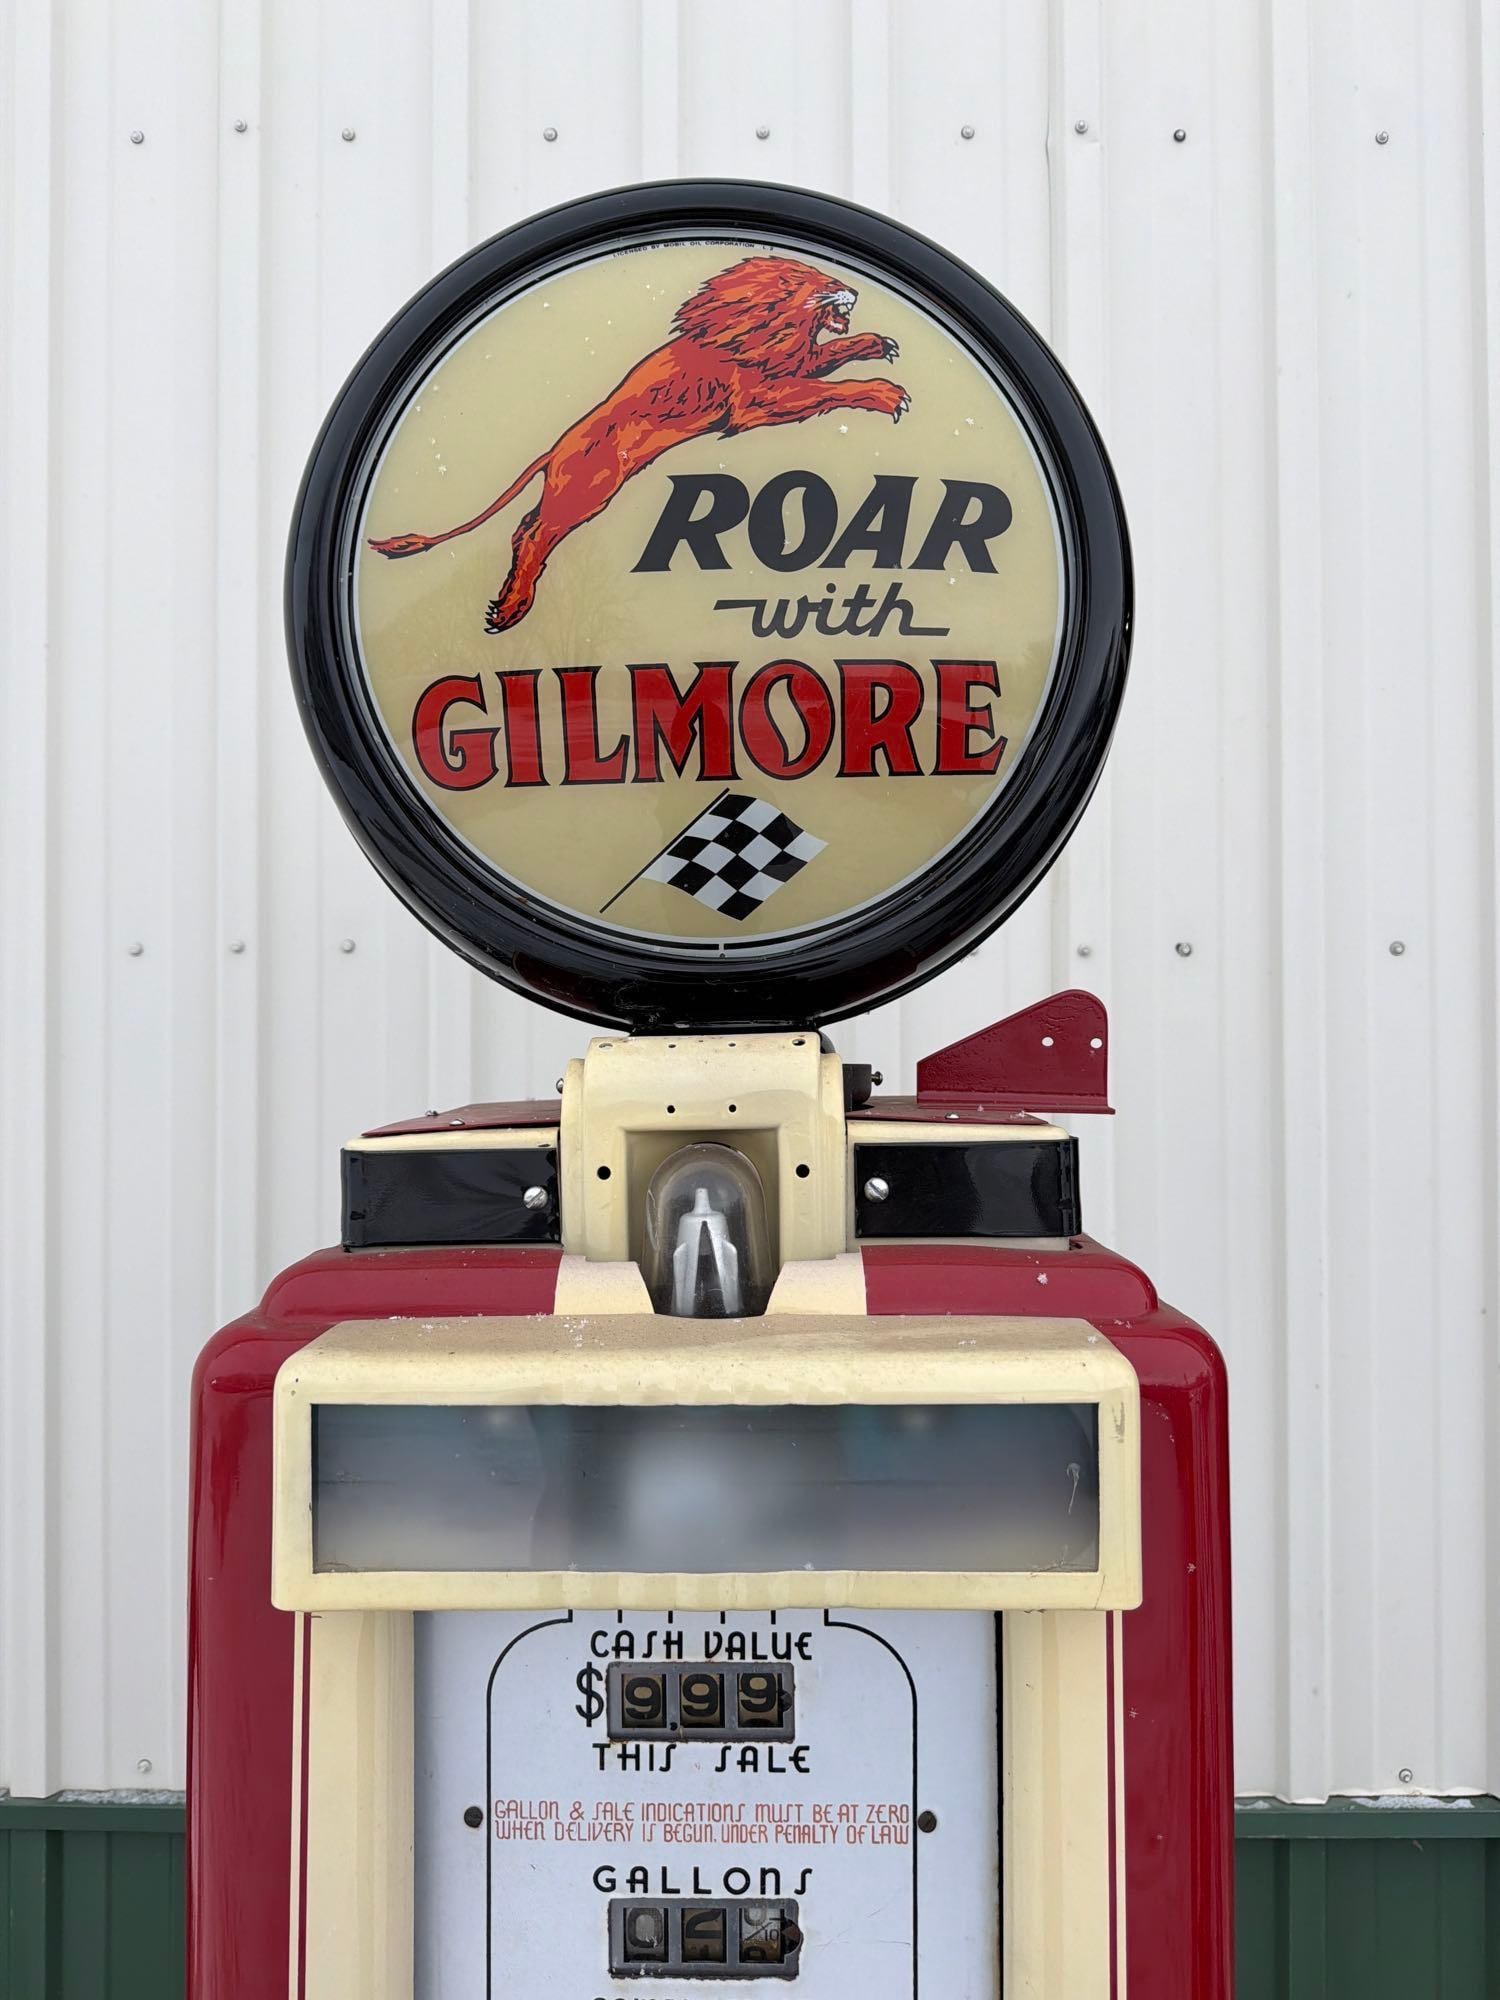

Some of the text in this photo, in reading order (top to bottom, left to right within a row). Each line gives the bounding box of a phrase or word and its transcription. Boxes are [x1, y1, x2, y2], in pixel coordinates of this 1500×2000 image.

[613, 247, 647, 258] LICENSED
[705, 240, 755, 249] CORPORATION
[630, 470, 1012, 574] ROAR
[714, 582, 950, 638] with
[412, 659, 1006, 788] GILMORE
[591, 1630, 813, 1661] CASH VALUE
[592, 1743, 810, 1774] THIS SALE
[495, 1800, 909, 1824] GALLON & SALE INDICATIONS MUST BE AT ZERO
[495, 1820, 546, 1841] WHEN
[554, 1821, 634, 1842] DELIVERY
[642, 1822, 656, 1842] IS
[721, 1824, 768, 1844] UNDER
[775, 1824, 838, 1844] PENALTY
[847, 1825, 867, 1844] OF
[872, 1825, 909, 1844] LAW
[592, 1865, 813, 1896] GALLONS
